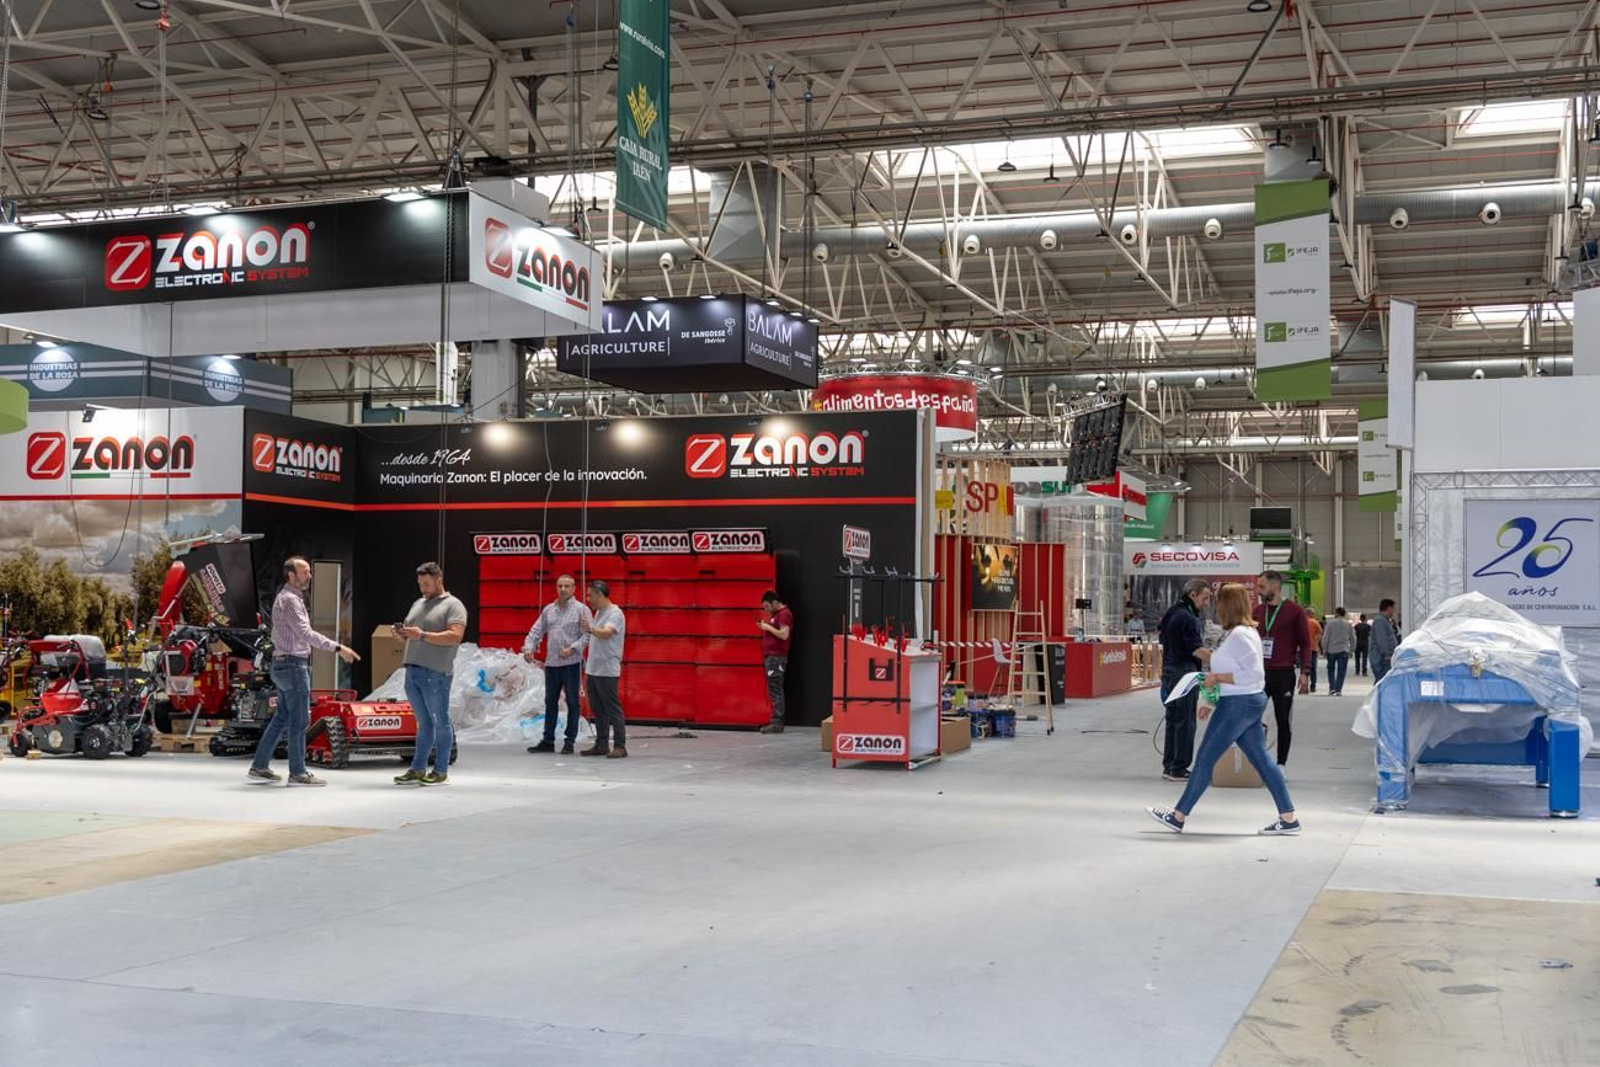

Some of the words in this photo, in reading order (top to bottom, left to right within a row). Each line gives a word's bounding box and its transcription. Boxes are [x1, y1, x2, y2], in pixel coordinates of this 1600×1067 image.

[155, 269, 245, 288] ELECTRONIC
[247, 266, 308, 281] SYSTEM
[601, 309, 670, 333] LAM
[748, 310, 792, 347] BALAM
[571, 341, 666, 355] AGRICULTURE
[750, 342, 790, 366] AGRICULTURE
[29, 372, 40, 380] DE
[42, 372, 54, 380] LA
[55, 371, 79, 379] ROSA
[30, 362, 78, 371] INDUSTRIAS
[430, 448, 471, 468] 1964
[380, 472, 443, 487] Maquinaria
[446, 471, 487, 484] Zanon:
[490, 470, 501, 482] El
[503, 470, 542, 485] placer
[544, 469, 560, 481] de
[563, 469, 575, 481] la
[577, 468, 648, 481] innovación.
[730, 466, 808, 478] ELECTRONIC
[810, 467, 864, 476] SYSTEM
[1150, 551, 1240, 562] SECOVISA
[1472, 516, 1595, 579] 25
[1508, 585, 1558, 597] años
